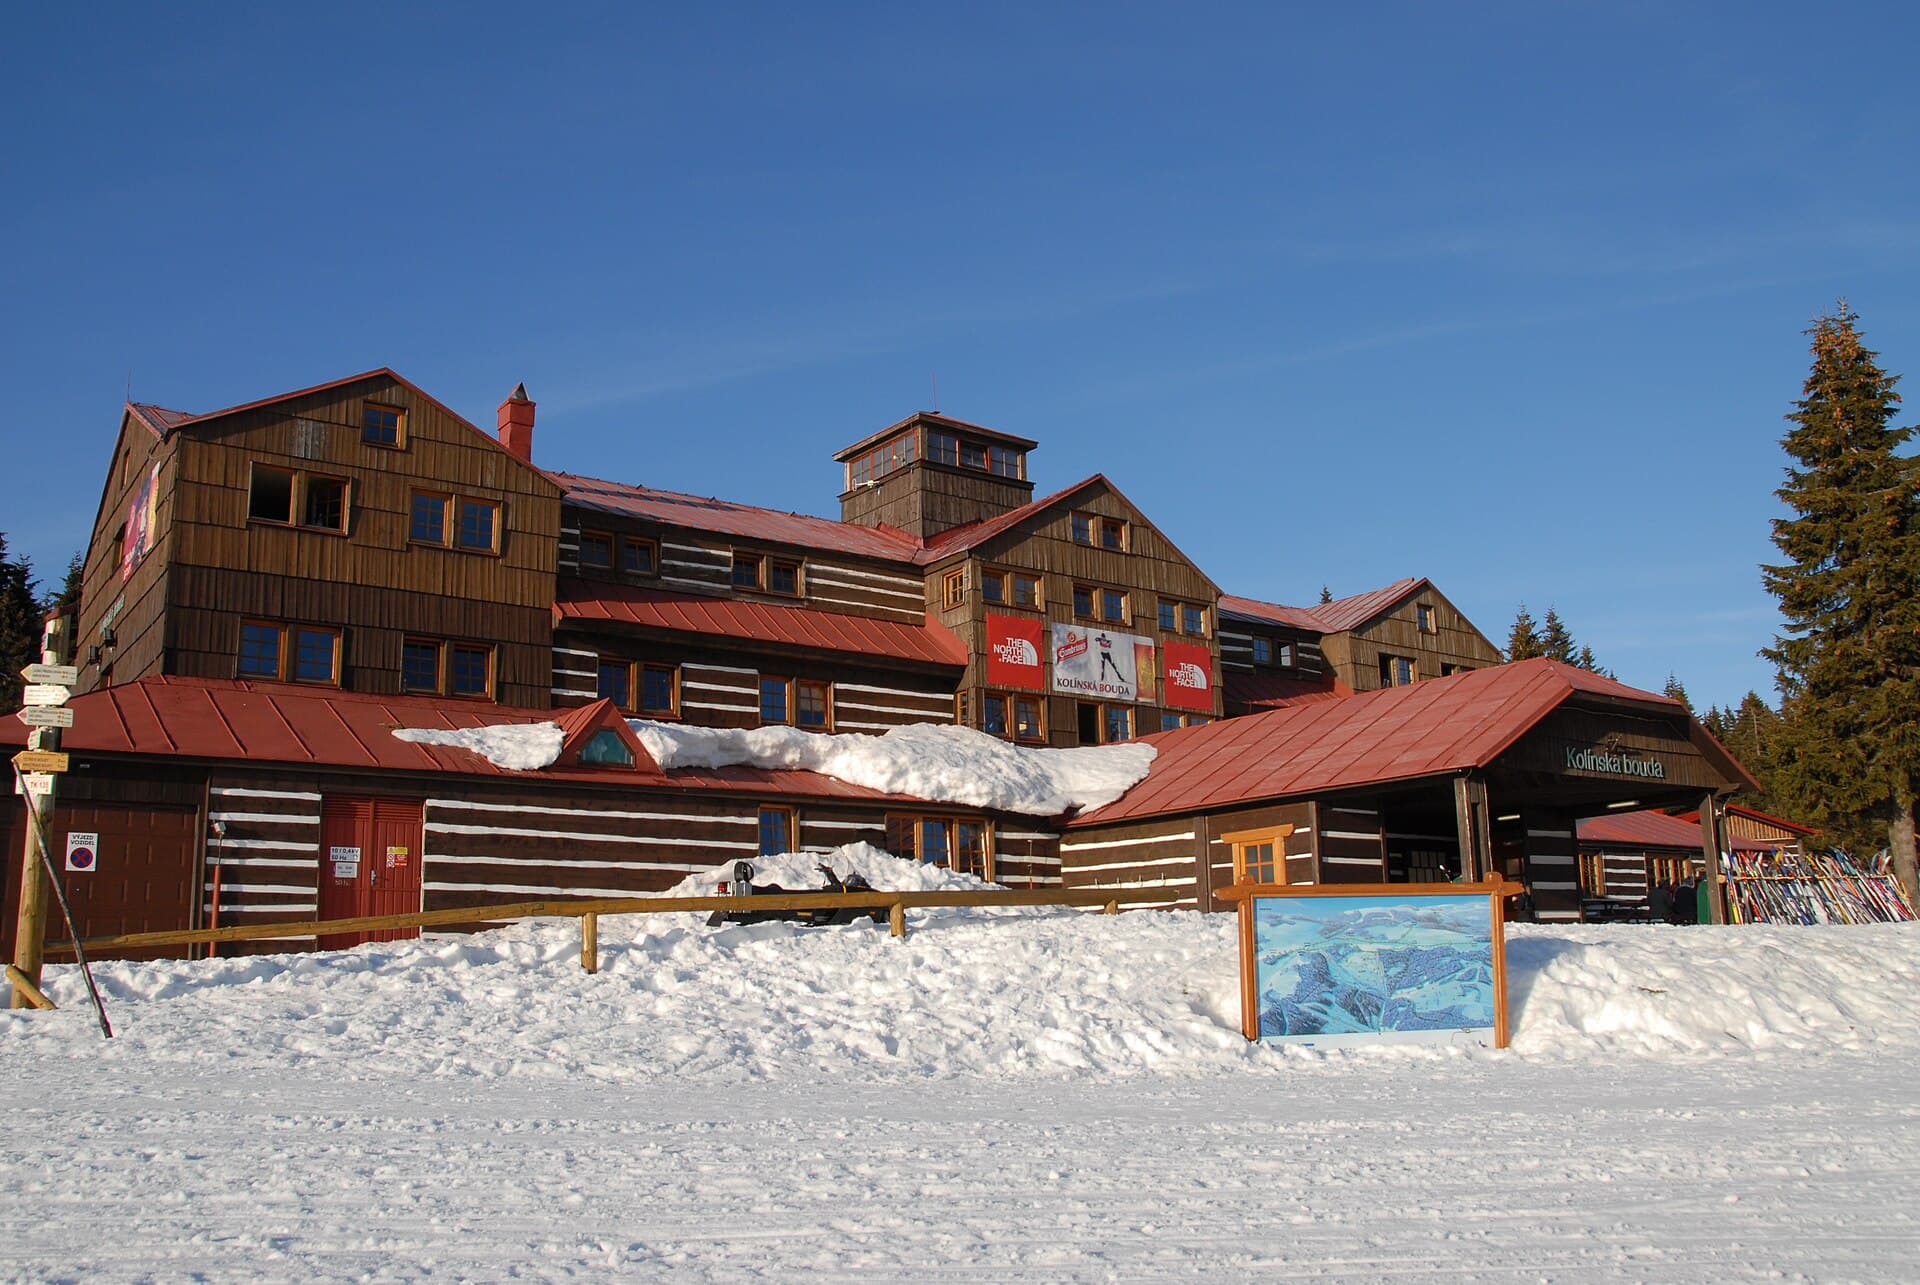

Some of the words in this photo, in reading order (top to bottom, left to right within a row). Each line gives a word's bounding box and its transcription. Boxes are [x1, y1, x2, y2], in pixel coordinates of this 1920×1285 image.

[1006, 637, 1023, 647] THE
[993, 644, 1023, 656] NORTH
[1002, 654, 1023, 664] FACE
[1179, 662, 1194, 672] THE
[1169, 669, 1194, 680] NORTH
[1057, 677, 1098, 691] KOLÍNSKÁ
[1099, 682, 1130, 695] BOUDA
[1176, 678, 1195, 687] FACE
[1566, 746, 1621, 773] Kolínská
[1623, 754, 1664, 778] bouda
